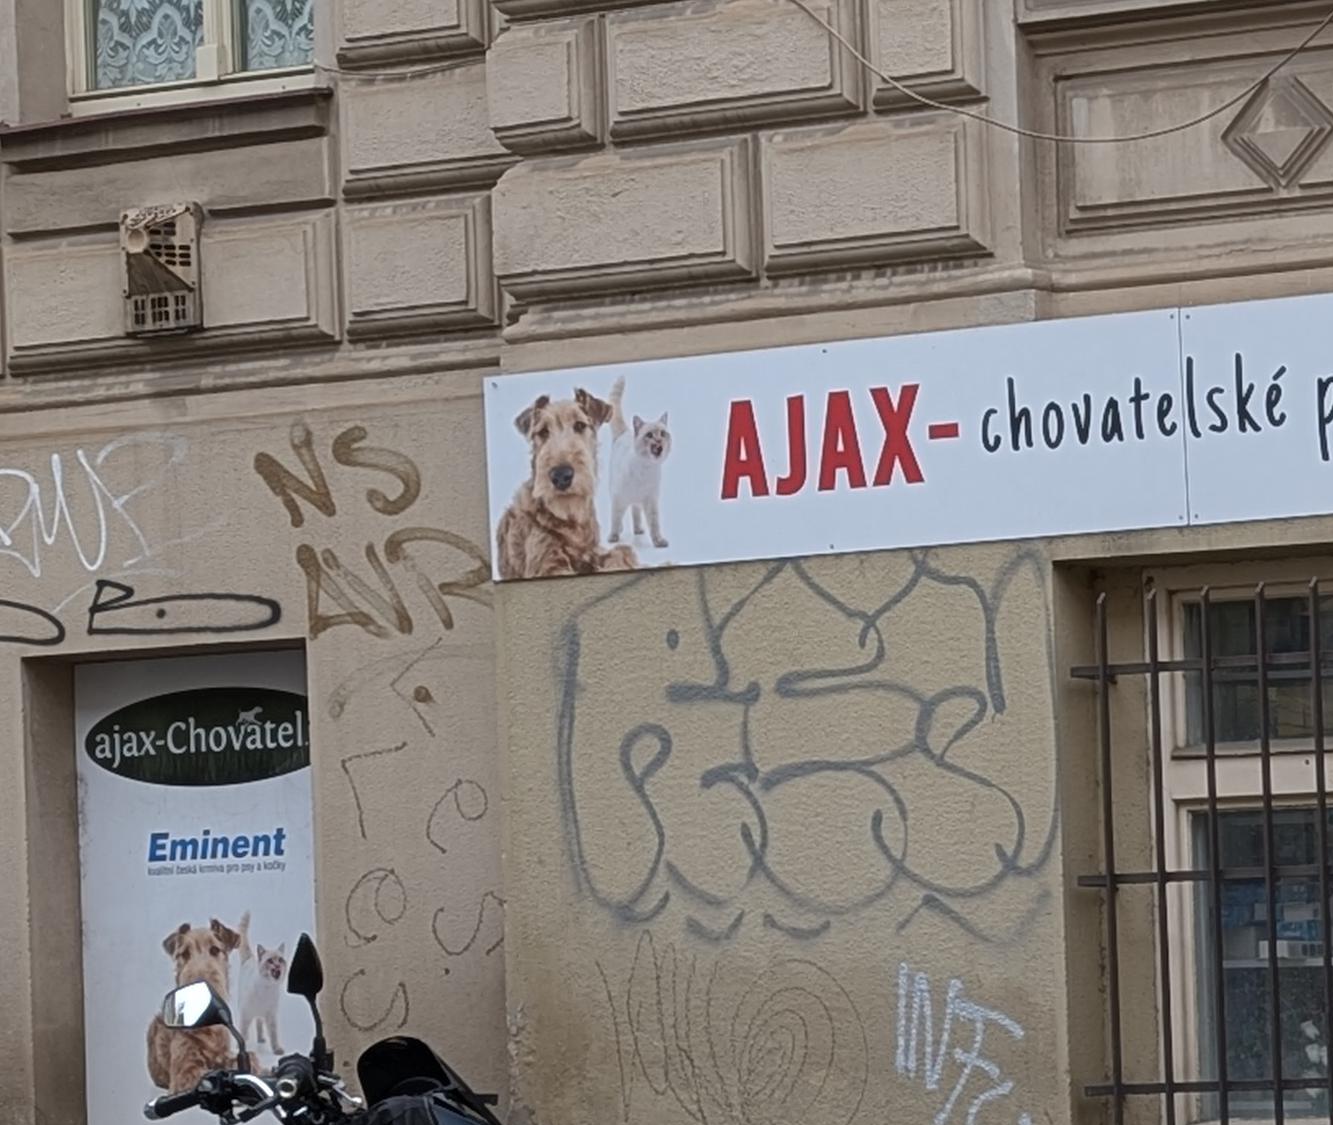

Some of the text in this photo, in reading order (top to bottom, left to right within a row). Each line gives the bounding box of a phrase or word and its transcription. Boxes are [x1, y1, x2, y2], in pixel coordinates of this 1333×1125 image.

[722, 383, 960, 499] AJAX-
[980, 352, 1289, 454] chovatelské
[147, 827, 286, 862] Eminent
